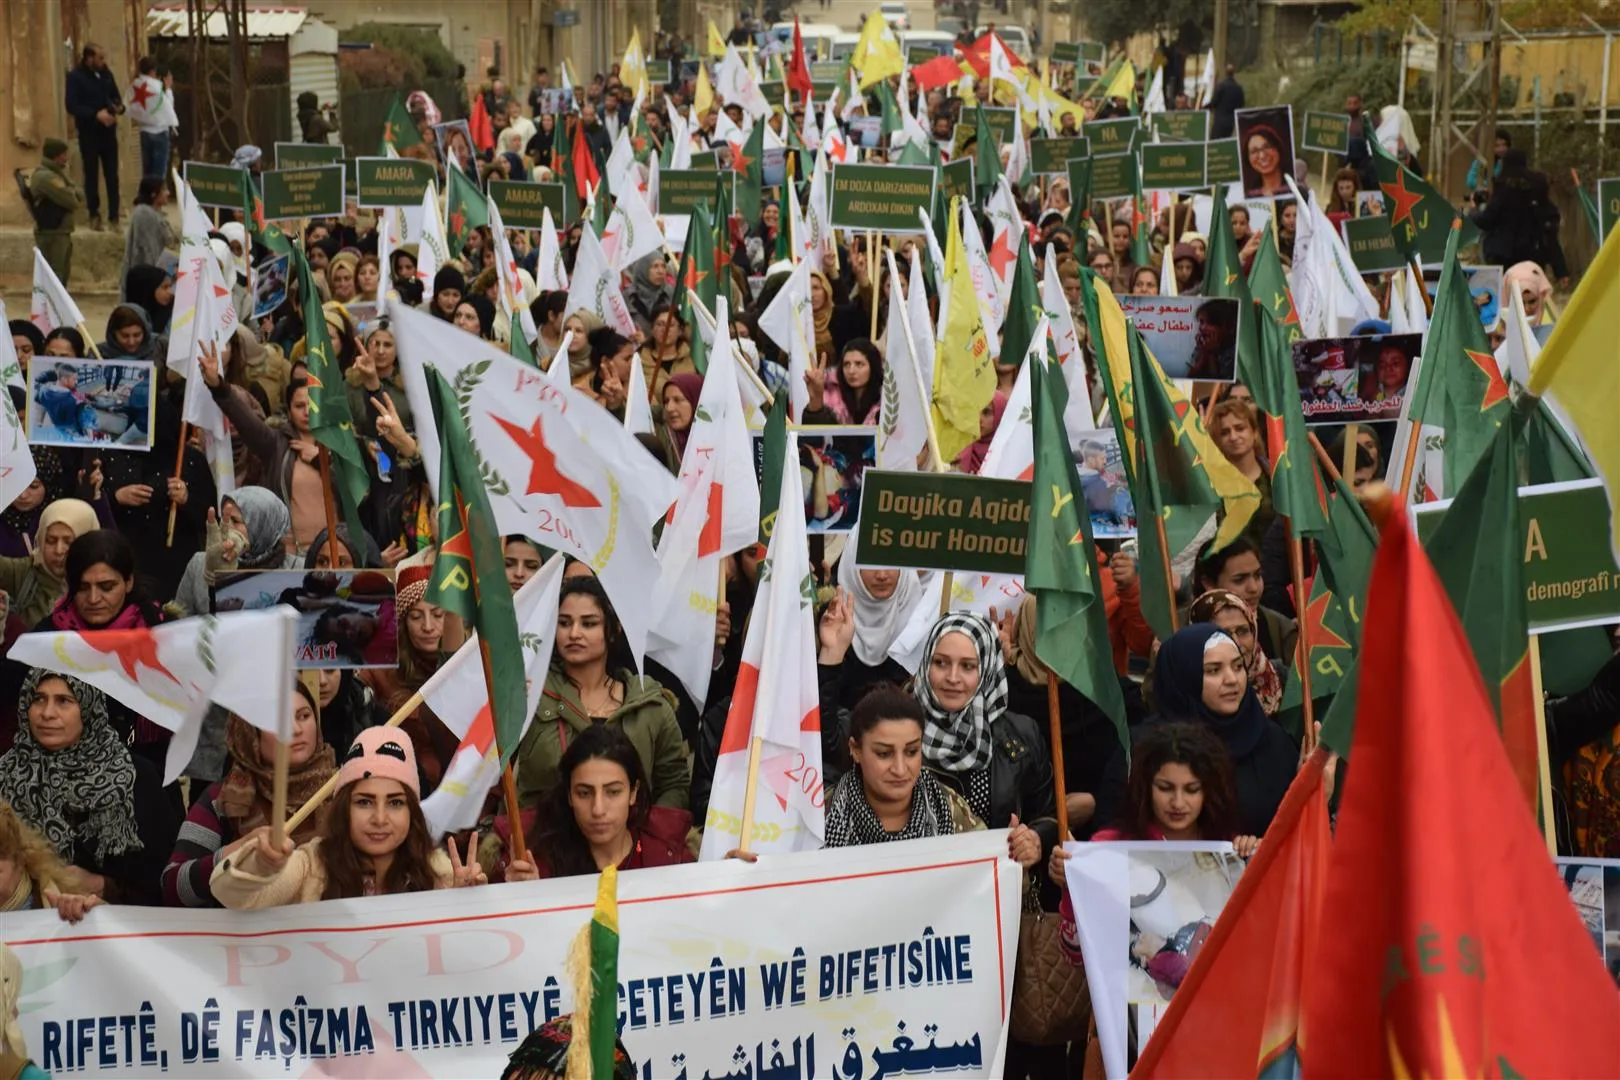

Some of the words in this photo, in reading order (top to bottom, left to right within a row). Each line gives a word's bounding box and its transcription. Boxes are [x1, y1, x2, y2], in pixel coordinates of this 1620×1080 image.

[375, 167, 415, 181] AMARA
[835, 179, 848, 191] EM
[850, 180, 873, 192] DOZA
[874, 181, 930, 196] DARIZANDINA
[505, 189, 542, 204] AMARA
[1353, 240, 1367, 252] EM
[878, 489, 963, 521] Dayika
[871, 523, 894, 547] is
[900, 528, 942, 549] our
[947, 528, 1028, 556] Honou
[1527, 571, 1609, 602] demografî
[219, 929, 526, 988] PYD
[43, 1000, 168, 1072] RIFETÊ,
[181, 997, 221, 1064] DÊ
[235, 995, 374, 1071] FAŞÎZMA
[388, 975, 561, 1051] TIRKIYEYÊ
[760, 946, 806, 1011] WÊ
[819, 926, 973, 1001] BIFETISÎNE
